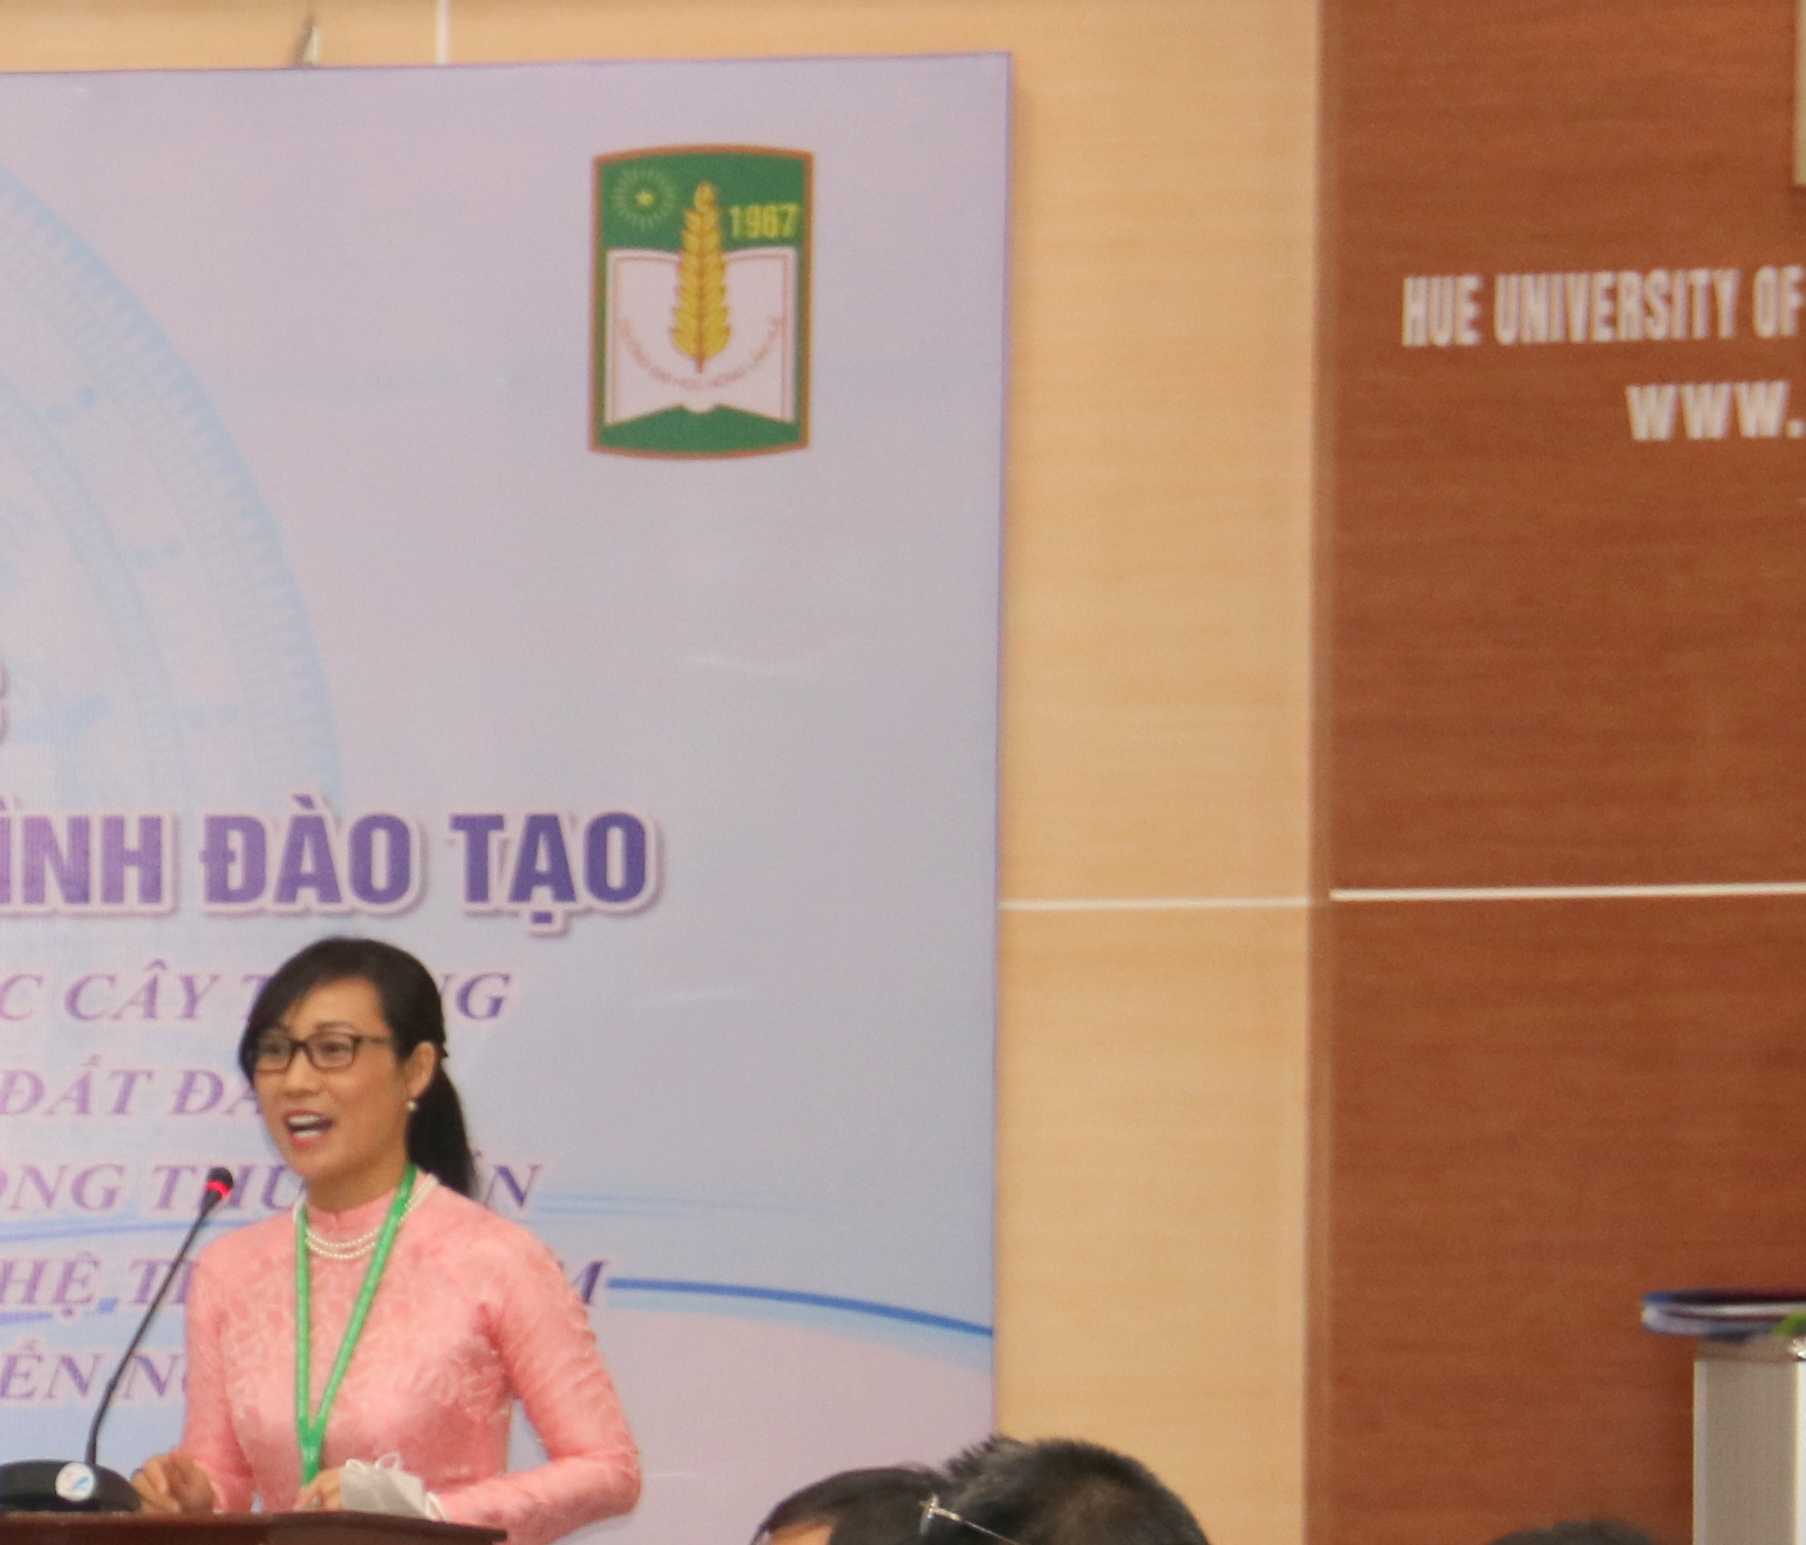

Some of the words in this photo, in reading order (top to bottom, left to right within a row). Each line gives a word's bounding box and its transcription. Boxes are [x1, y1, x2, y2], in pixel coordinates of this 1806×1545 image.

[728, 201, 800, 238] 1967
[1402, 274, 1482, 347] HUE
[1494, 268, 1739, 345] UNIVERSITY
[1753, 264, 1804, 338] OF
[202, 794, 413, 906] ĐÀO
[450, 811, 648, 926] TẠO
[62, 959, 231, 1022] CÂY
